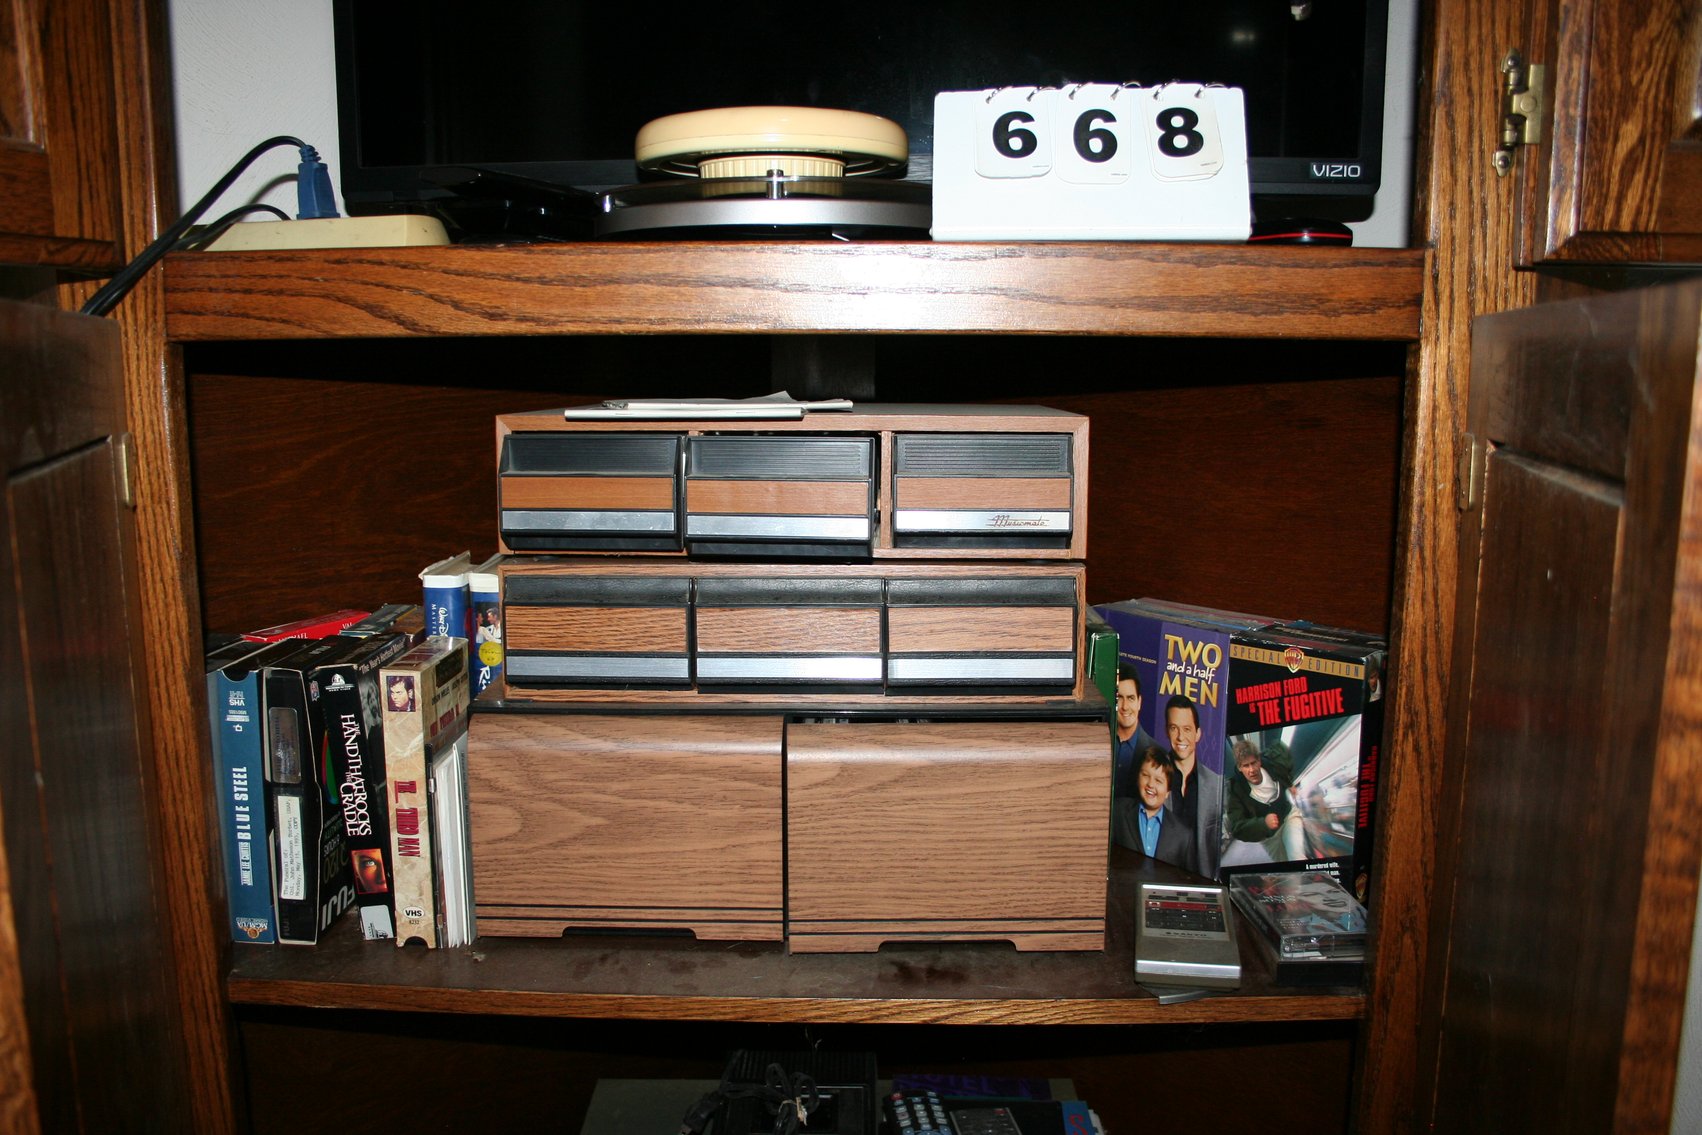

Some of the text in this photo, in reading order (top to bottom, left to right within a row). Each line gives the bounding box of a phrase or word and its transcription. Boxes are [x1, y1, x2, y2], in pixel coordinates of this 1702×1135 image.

[991, 107, 1204, 164] 6 6 8
[1312, 164, 1362, 179] VIZIO
[1164, 634, 1223, 669] TWO
[1232, 646, 1281, 664] SPECIAL
[1308, 659, 1360, 678] EDITION
[1158, 671, 1219, 708] MEN
[1166, 661, 1217, 685] and a half
[1235, 676, 1308, 705] HARRISON FORD
[230, 699, 245, 707] VHS
[1257, 699, 1281, 727] THE
[1284, 687, 1345, 722] FUGITIVE
[341, 713, 372, 836] HAND THAT ROCKS
[232, 766, 251, 840] BLUE STEEL
[340, 782, 360, 837] CRADLE
[397, 837, 421, 858] MAN
[321, 885, 355, 932] FUJI
[405, 909, 422, 917] VHS
